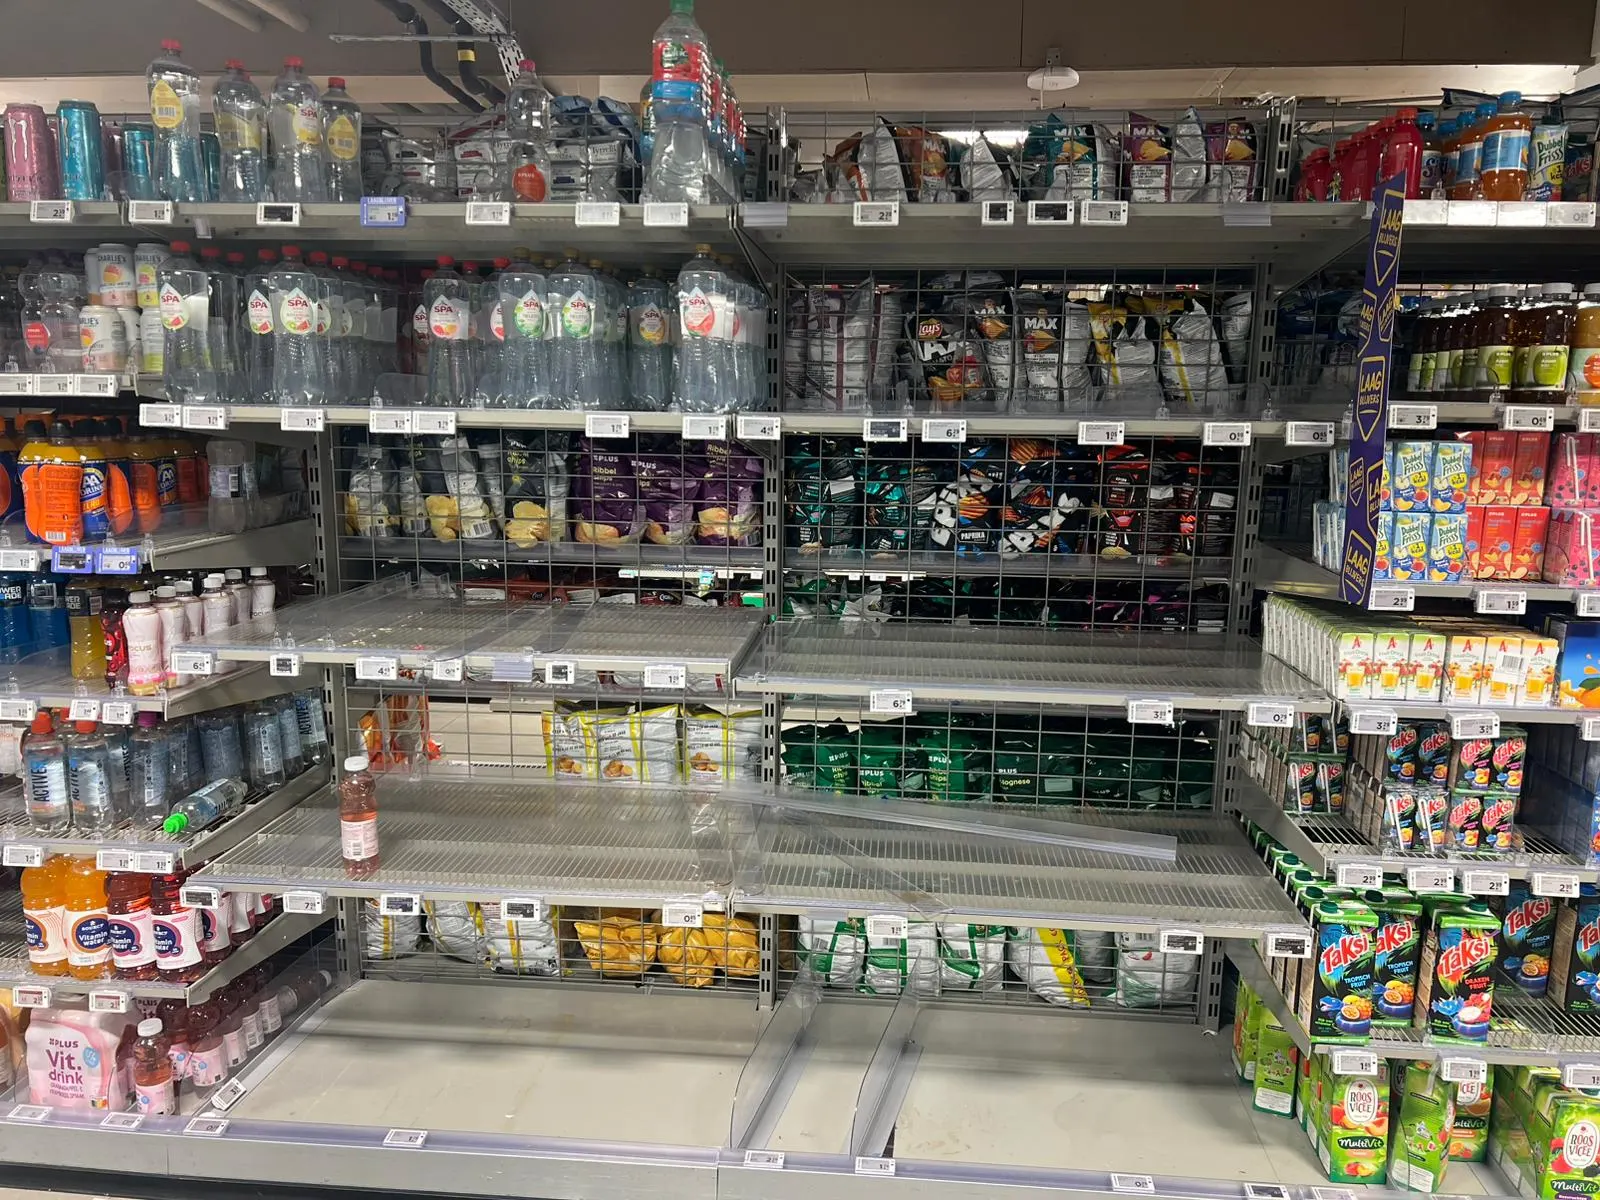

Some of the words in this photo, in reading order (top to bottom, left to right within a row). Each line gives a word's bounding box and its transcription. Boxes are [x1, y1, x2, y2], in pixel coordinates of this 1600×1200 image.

[1537, 136, 1563, 154] Dubbel
[1382, 208, 1402, 231] LAAG
[161, 295, 180, 303] SPA
[250, 301, 268, 309] SPA
[288, 299, 309, 307] SPA
[570, 301, 588, 309] SPA
[689, 298, 706, 306] SPA
[644, 311, 659, 319] SPA
[1024, 317, 1058, 330] MAX
[1360, 371, 1382, 393] LAAG
[601, 454, 619, 463] PLUS
[593, 466, 617, 475] Ribbel
[639, 461, 657, 469] PLUS
[83, 474, 101, 487] AA
[961, 530, 986, 541] PAPRIKA
[1347, 547, 1368, 575] LAAG
[296, 705, 312, 735] ACTIVE
[864, 769, 884, 777] PLUS
[30, 767, 50, 802] ACTIVE
[70, 767, 79, 801] ACTIVE
[79, 932, 108, 942] Vitamin
[82, 938, 105, 947] water
[1376, 920, 1412, 955] aKSi
[1320, 933, 1370, 975] TaKSi
[1438, 938, 1490, 978] TaKSi
[1387, 960, 1414, 972] TROPISCH
[1394, 966, 1409, 975] FRUIT
[1344, 973, 1371, 985] TROPISCH
[1351, 981, 1367, 989] FRUIT
[1469, 982, 1488, 990] FRUIT
[55, 1039, 79, 1049] PLUS
[46, 1050, 82, 1072] Vit.
[48, 1067, 83, 1084] drink
[1350, 1091, 1372, 1103] ROOS
[1349, 1100, 1373, 1114] VICEE
[1452, 1118, 1485, 1129] ultiVit
[1338, 1137, 1384, 1149] MultiVit
[1570, 1134, 1594, 1147] ROOS
[1569, 1145, 1592, 1157] VICEE
[1552, 1180, 1599, 1193] MultiVit
